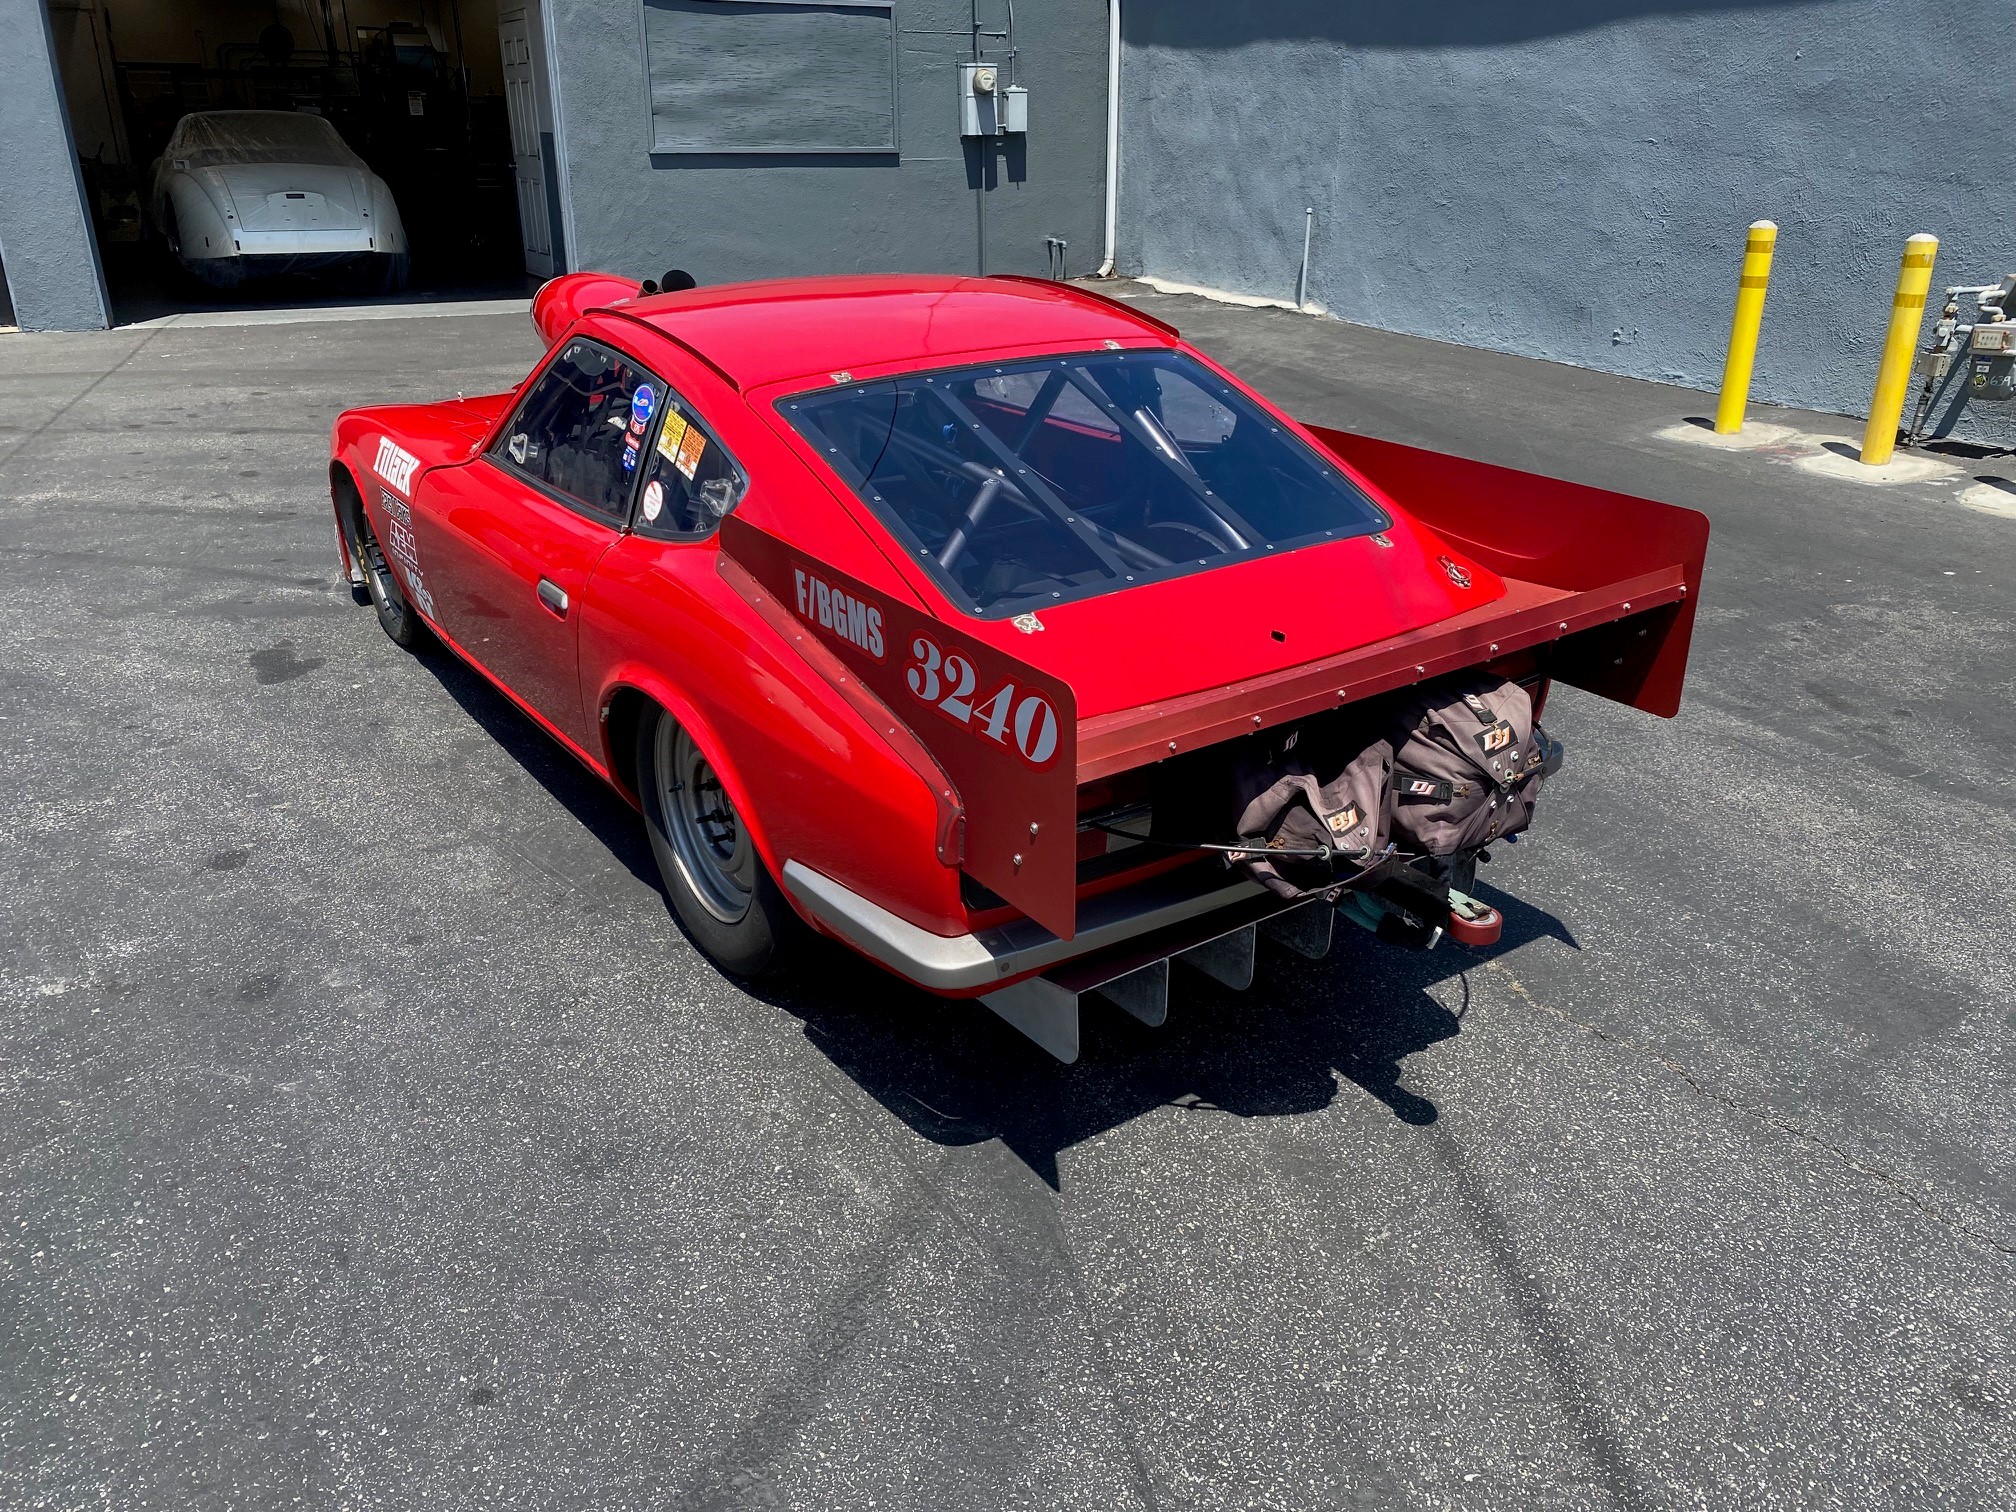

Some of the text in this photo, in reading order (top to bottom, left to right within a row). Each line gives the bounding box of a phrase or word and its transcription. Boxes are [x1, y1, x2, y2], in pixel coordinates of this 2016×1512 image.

[794, 568, 885, 658] F/BGMS
[907, 638, 1058, 763] 3240
[1482, 726, 1511, 752] DJ
[1409, 780, 1437, 796] DJ
